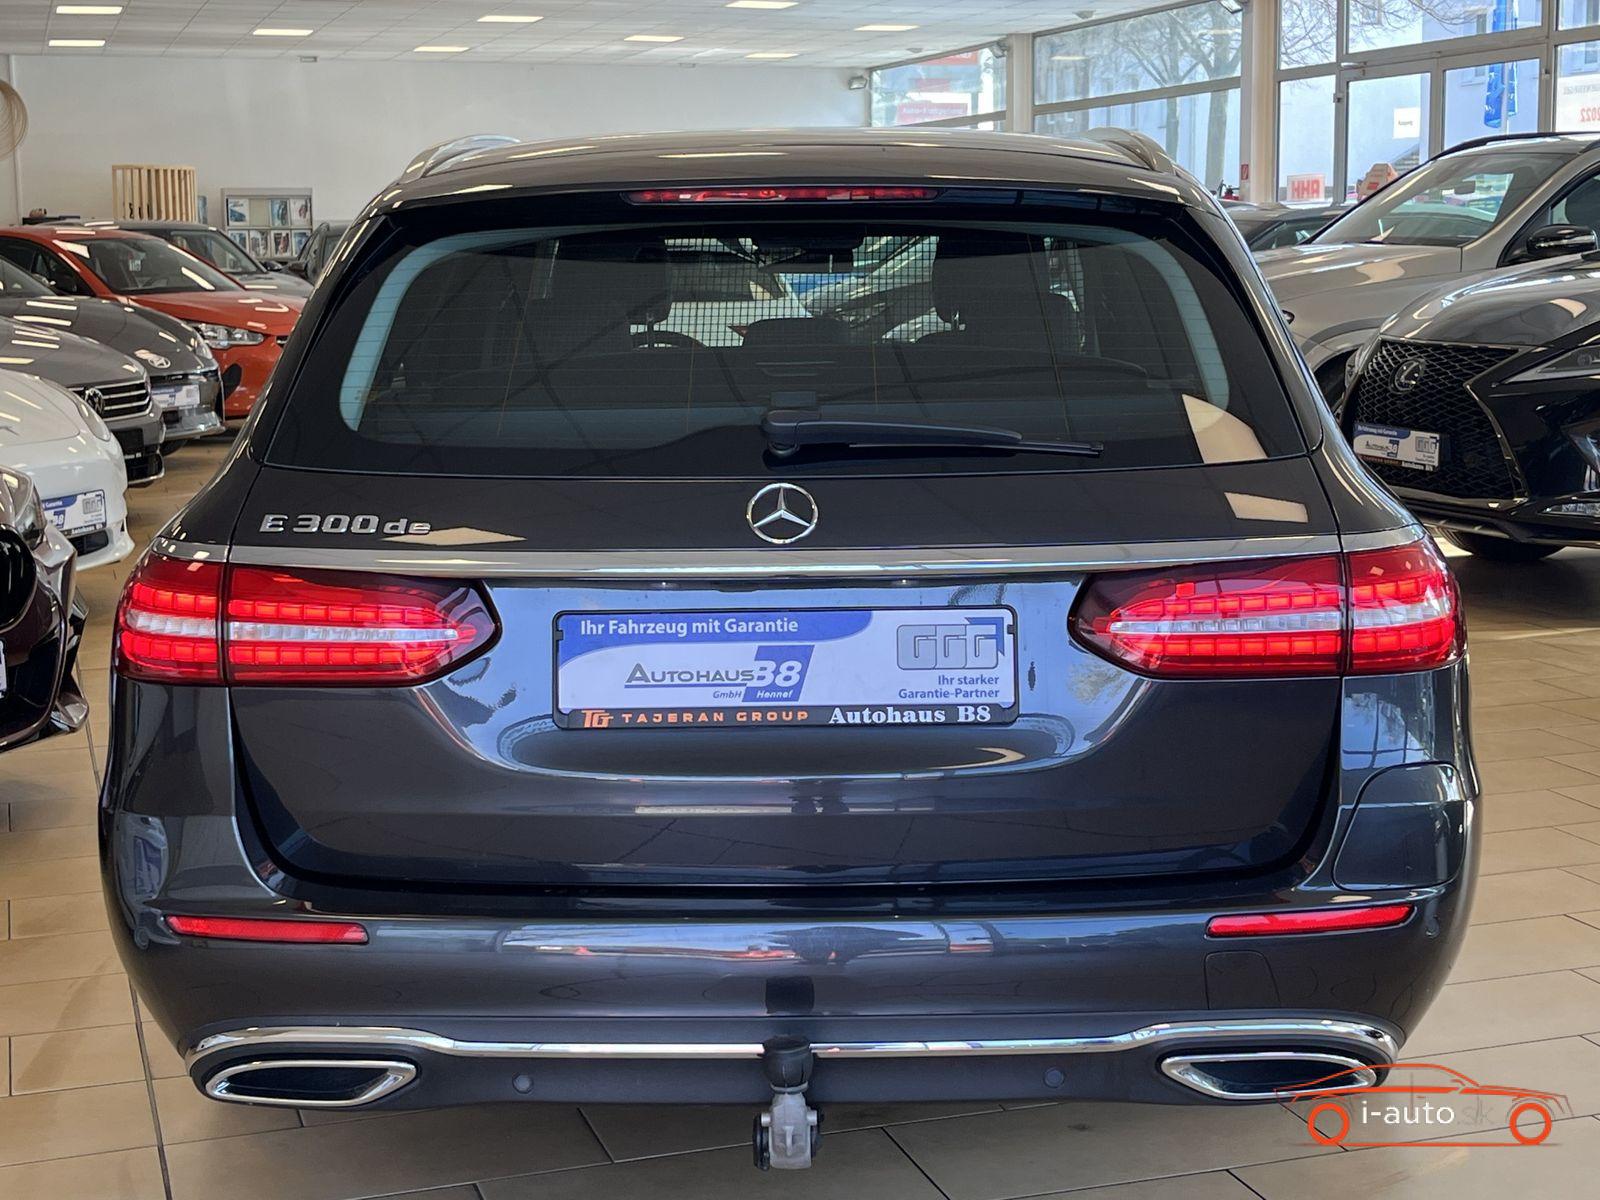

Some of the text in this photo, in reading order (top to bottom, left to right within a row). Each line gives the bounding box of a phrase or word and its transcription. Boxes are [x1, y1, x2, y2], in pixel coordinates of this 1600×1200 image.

[259, 514, 289, 534] E
[580, 617, 799, 637] Ihr Fahrzeug mit Garantie
[938, 675, 1000, 685] Ihr starker
[712, 690, 793, 700] GmbH Hennef
[898, 688, 1000, 699] Garantie-Partner
[622, 712, 725, 723] TAJERAN
[736, 711, 809, 722] GROUP
[828, 705, 991, 724] Autohaus B8
